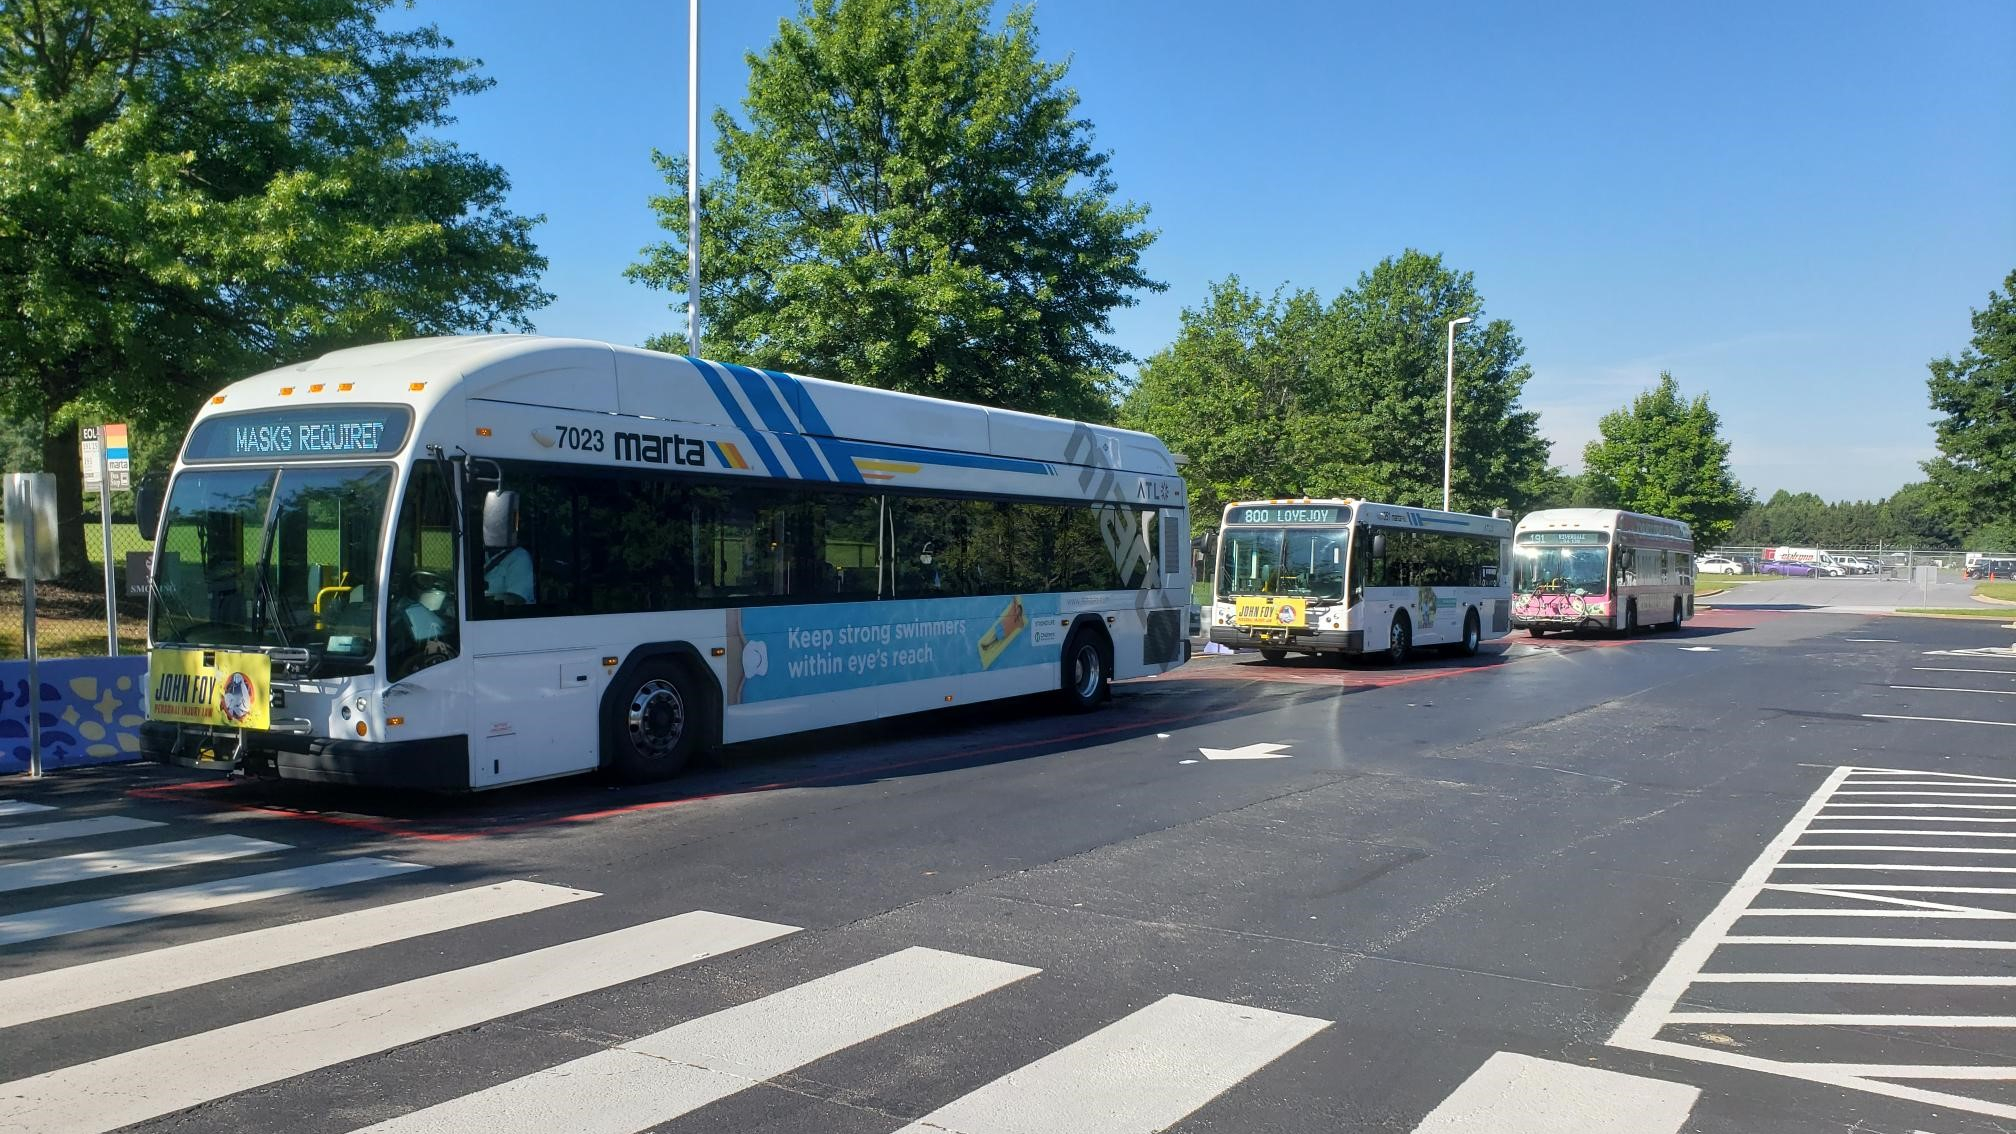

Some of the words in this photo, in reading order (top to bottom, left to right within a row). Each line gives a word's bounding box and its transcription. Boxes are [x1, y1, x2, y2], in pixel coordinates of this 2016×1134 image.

[83, 428, 97, 439] EOL
[236, 425, 293, 453] MASKS
[555, 425, 605, 453] 7023
[614, 431, 705, 467] marta
[109, 461, 128, 469] marta
[1137, 481, 1160, 500] ATL
[1245, 509, 1269, 523] 800
[1277, 509, 1329, 523] LOVEJOY
[1530, 534, 1545, 544] 191
[1239, 606, 1260, 617] JOHN
[788, 626, 834, 649] Keep
[838, 624, 891, 645] strong
[895, 618, 966, 639] swimmers
[788, 652, 843, 679] within
[847, 648, 888, 675] eye's
[892, 642, 933, 667] reach
[155, 673, 190, 703] JOHN
[192, 675, 216, 705] FOY
